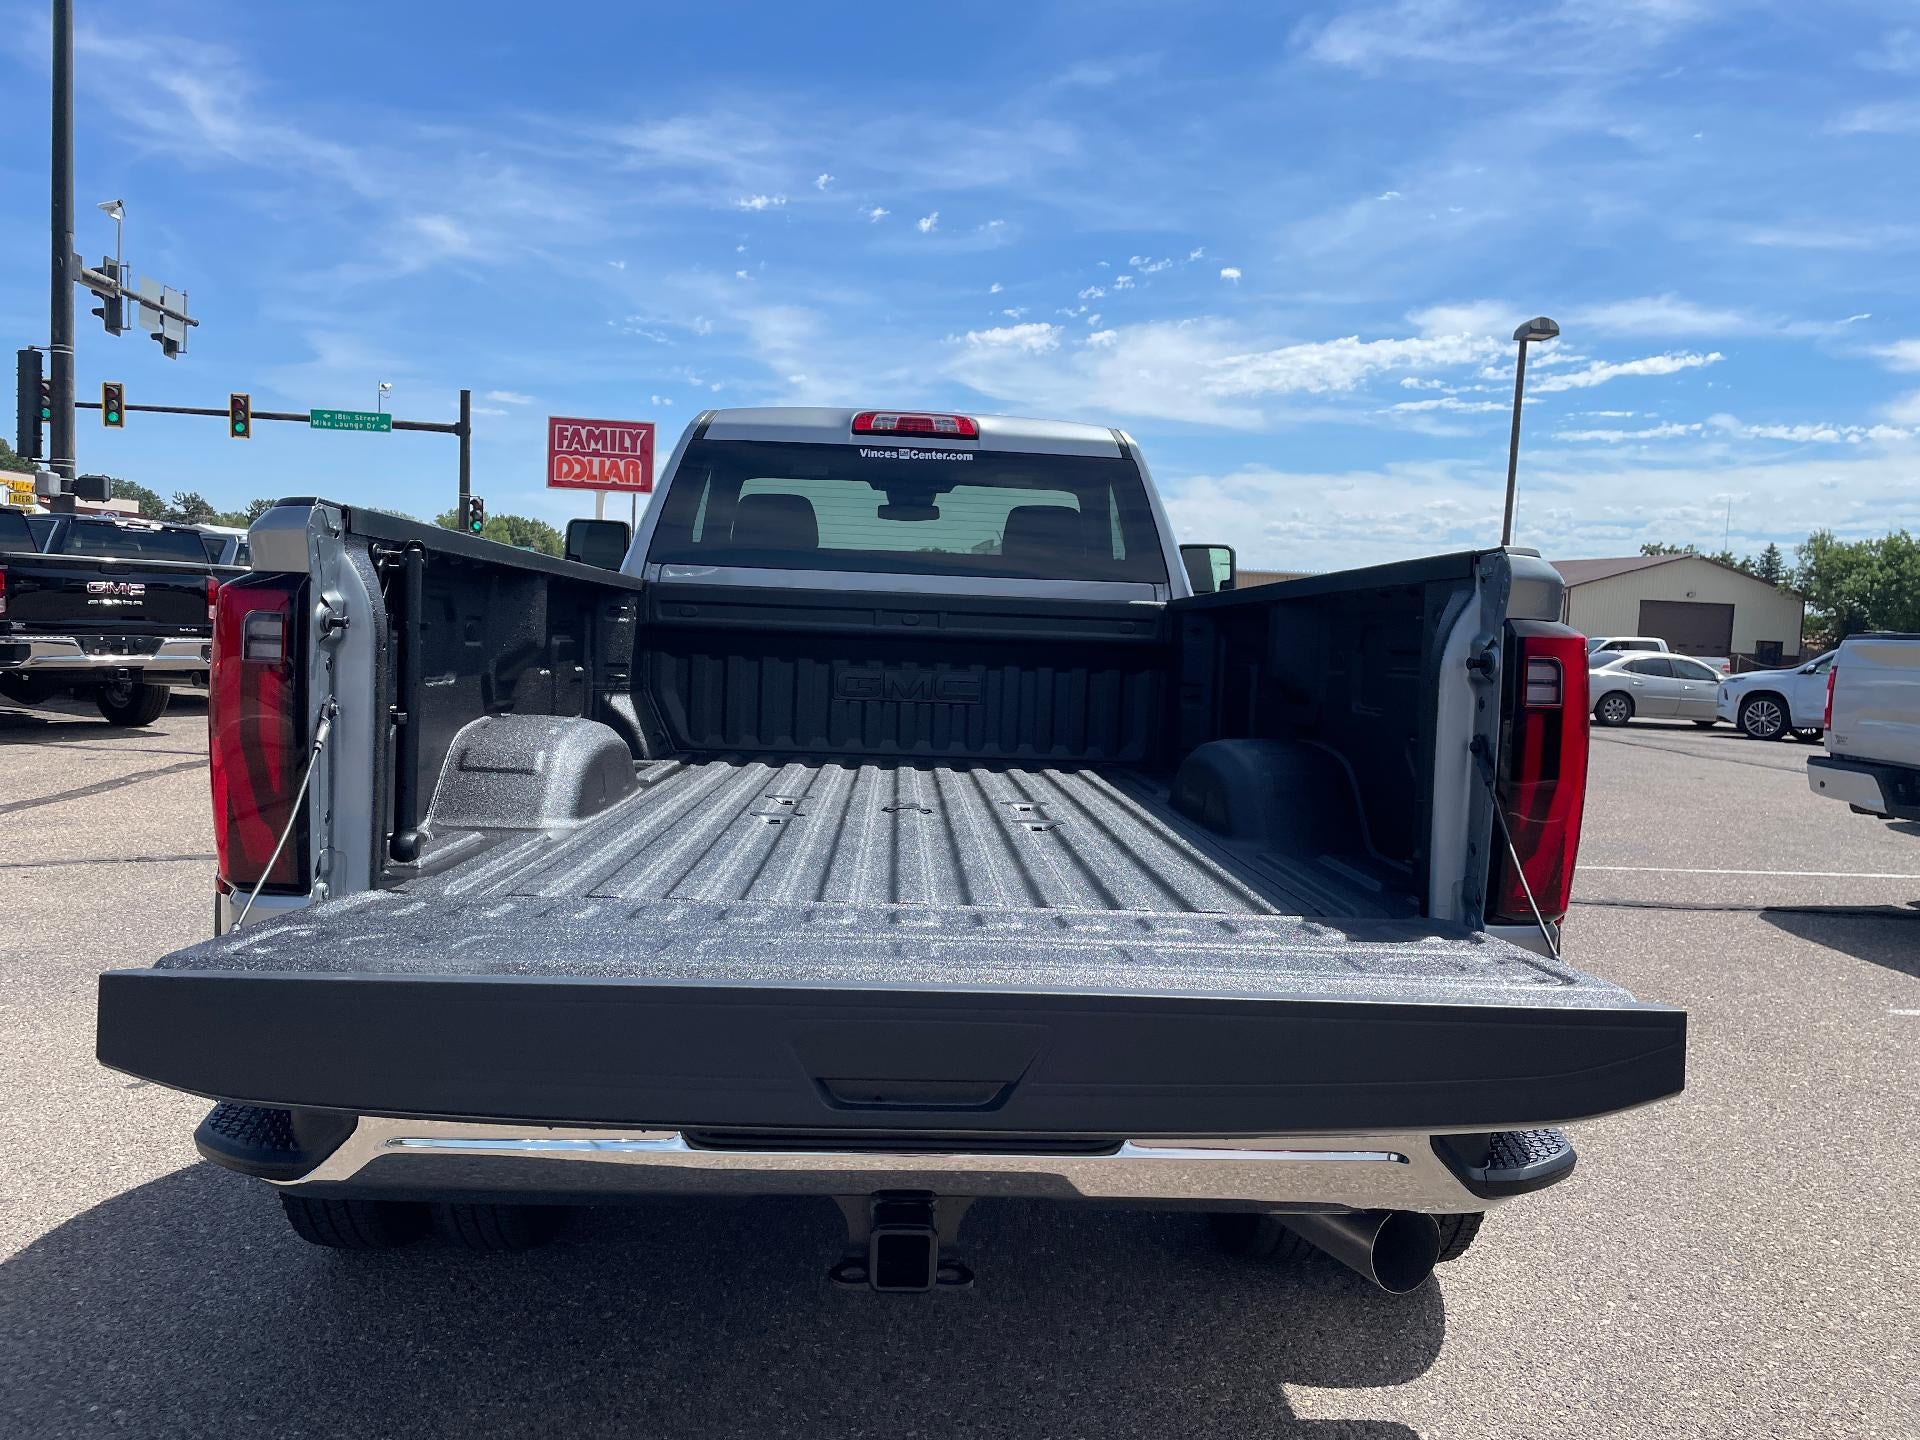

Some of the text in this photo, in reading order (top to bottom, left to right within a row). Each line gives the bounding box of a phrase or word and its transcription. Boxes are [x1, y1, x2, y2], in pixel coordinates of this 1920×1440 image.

[312, 419, 331, 427] Mike
[555, 424, 648, 455] FAMILY
[860, 448, 898, 459] Vinces
[911, 450, 974, 461] Center.com
[554, 454, 642, 486] DOLLAR
[86, 581, 146, 596] GMC
[835, 670, 981, 703] GMC
